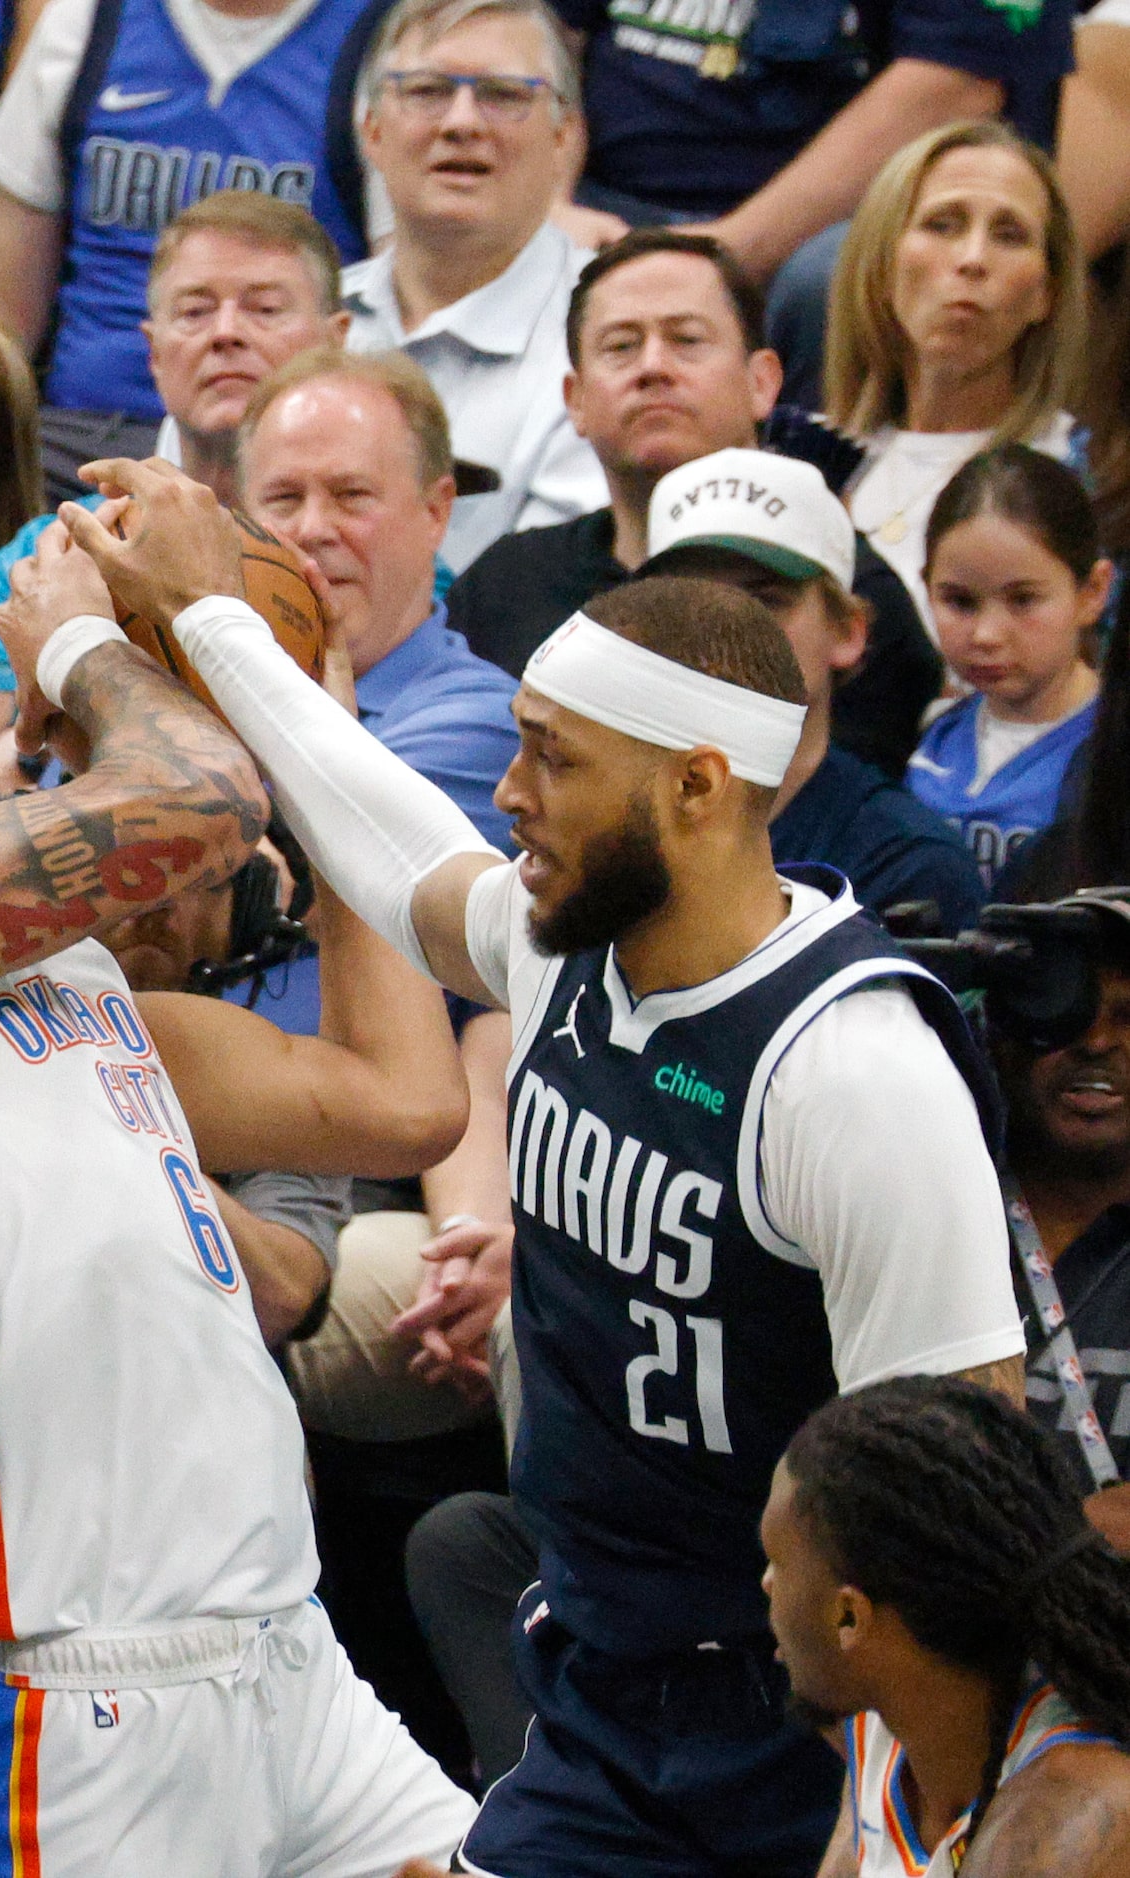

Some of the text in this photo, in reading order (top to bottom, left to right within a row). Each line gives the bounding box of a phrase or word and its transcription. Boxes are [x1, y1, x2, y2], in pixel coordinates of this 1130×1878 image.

[669, 478, 788, 521] DALLAS
[655, 1062, 726, 1116] chime
[159, 1146, 240, 1294] 6
[511, 1068, 724, 1300] MAVS
[626, 1298, 734, 1455] 21
